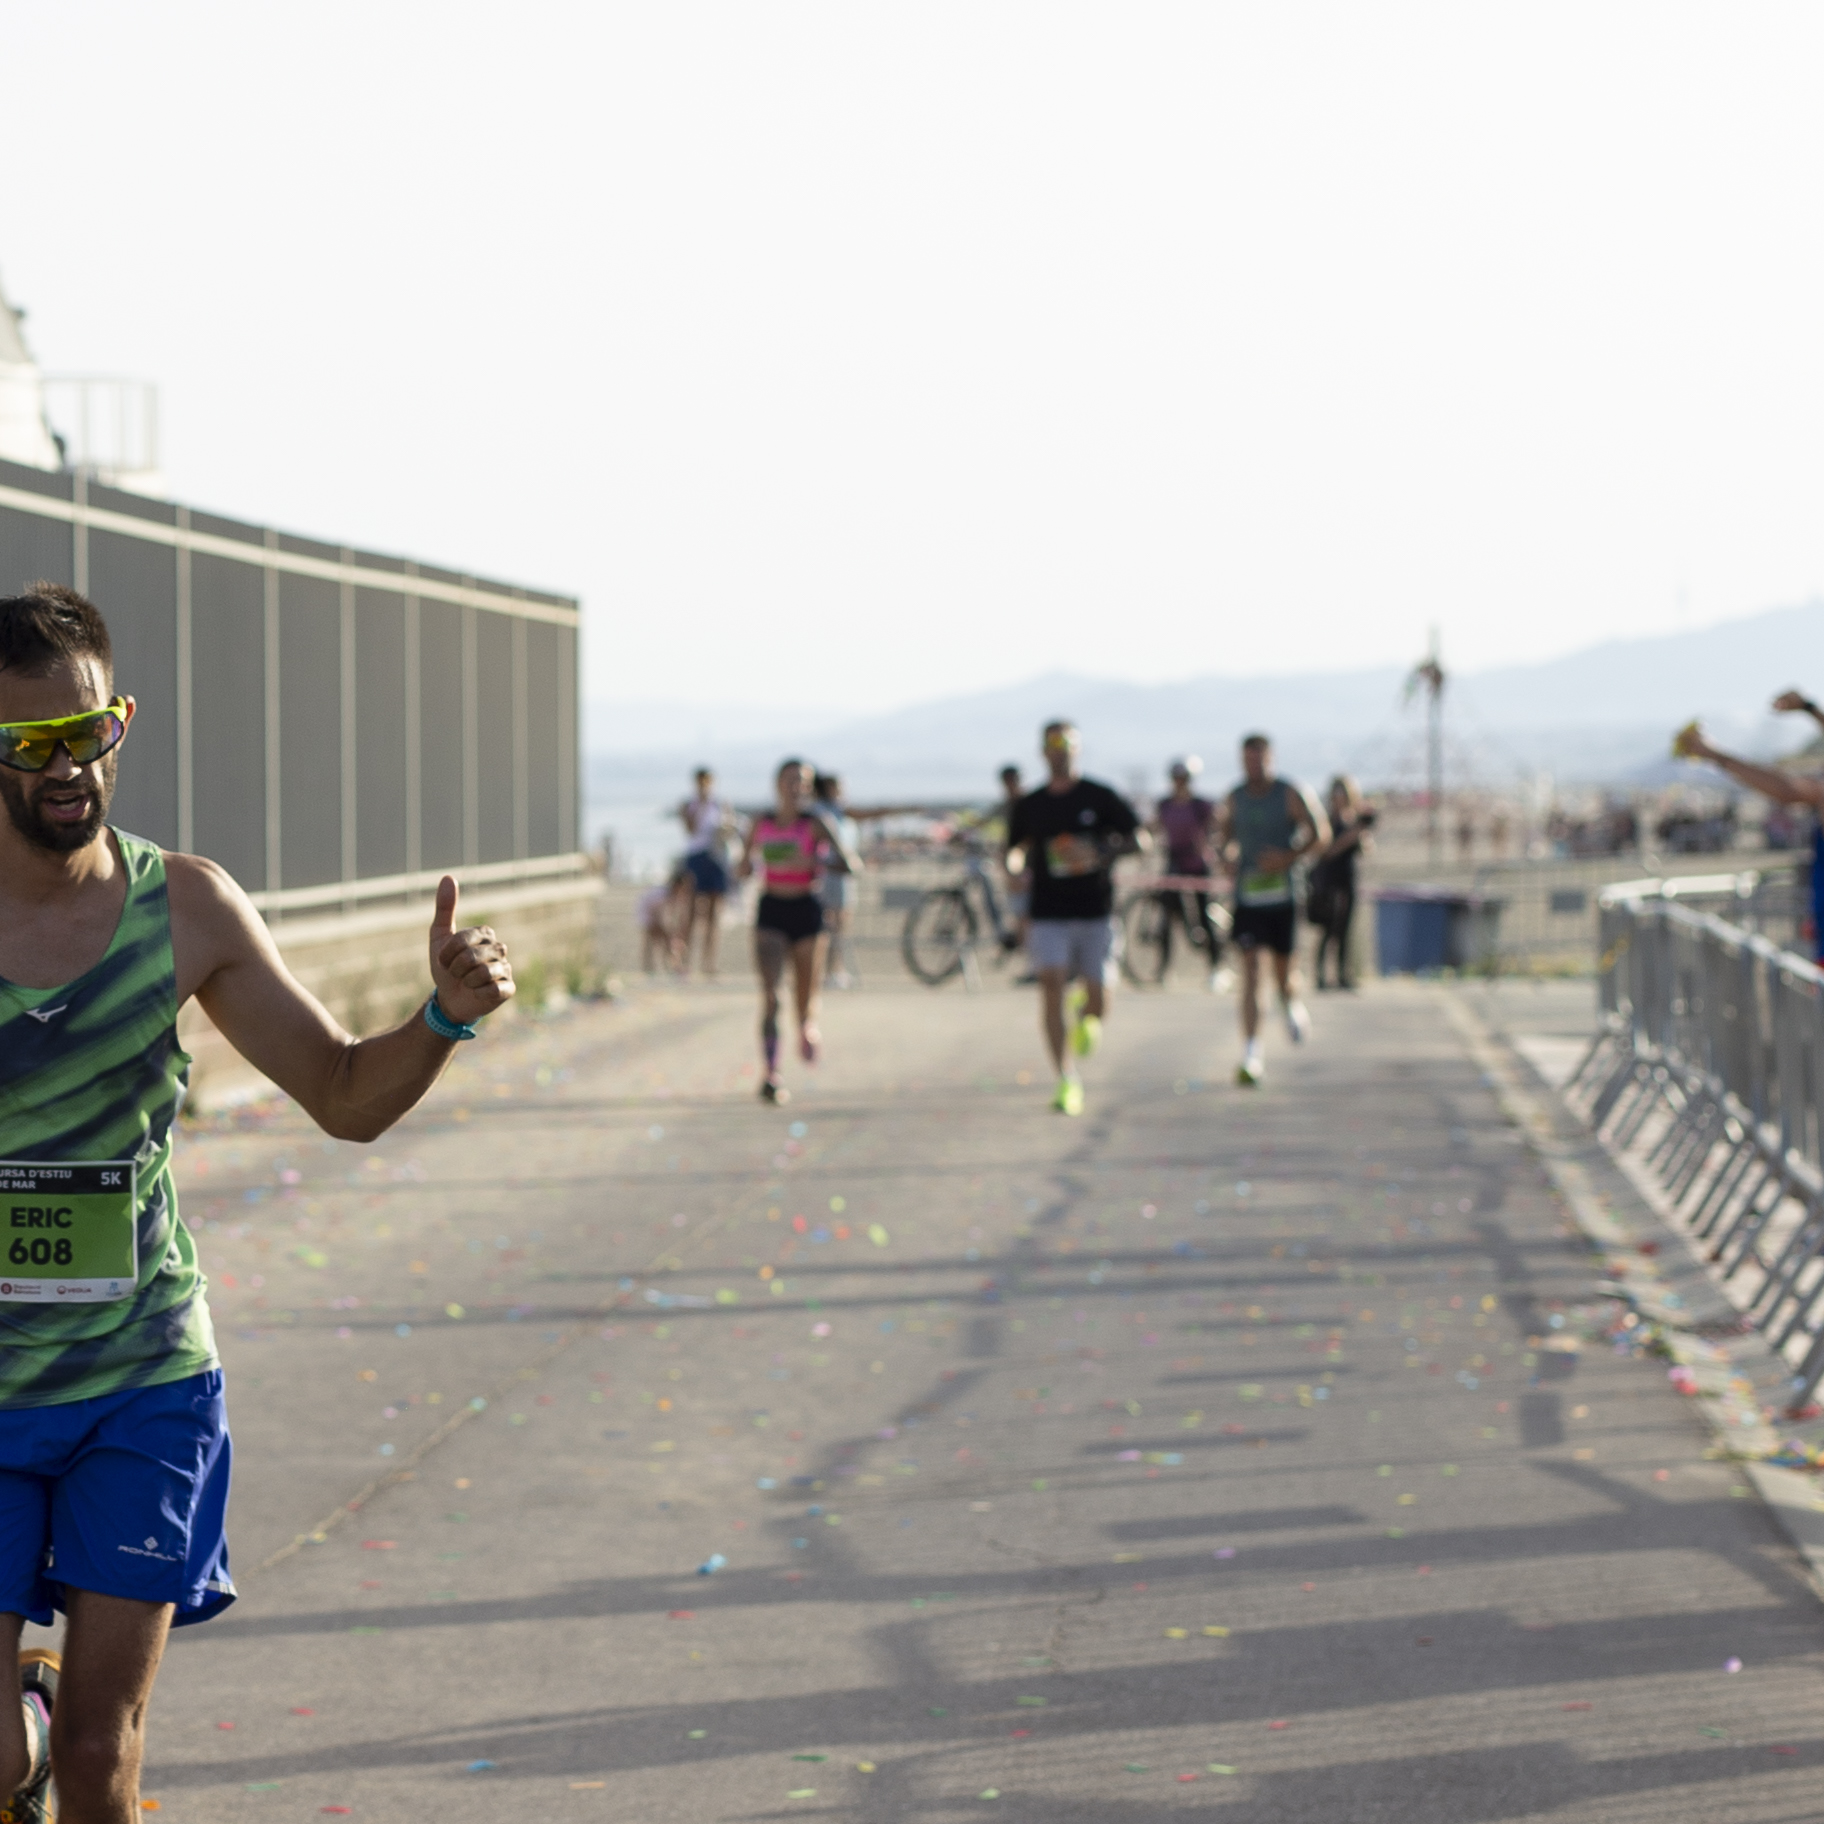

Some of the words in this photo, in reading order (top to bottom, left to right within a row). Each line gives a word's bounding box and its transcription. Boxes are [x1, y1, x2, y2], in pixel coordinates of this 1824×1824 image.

[28, 1169, 73, 1179] D'ESTIU
[100, 1171, 122, 1185] 5K
[12, 1180, 36, 1189] MAR
[10, 1206, 73, 1228] ERIC
[8, 1237, 73, 1266] 608
